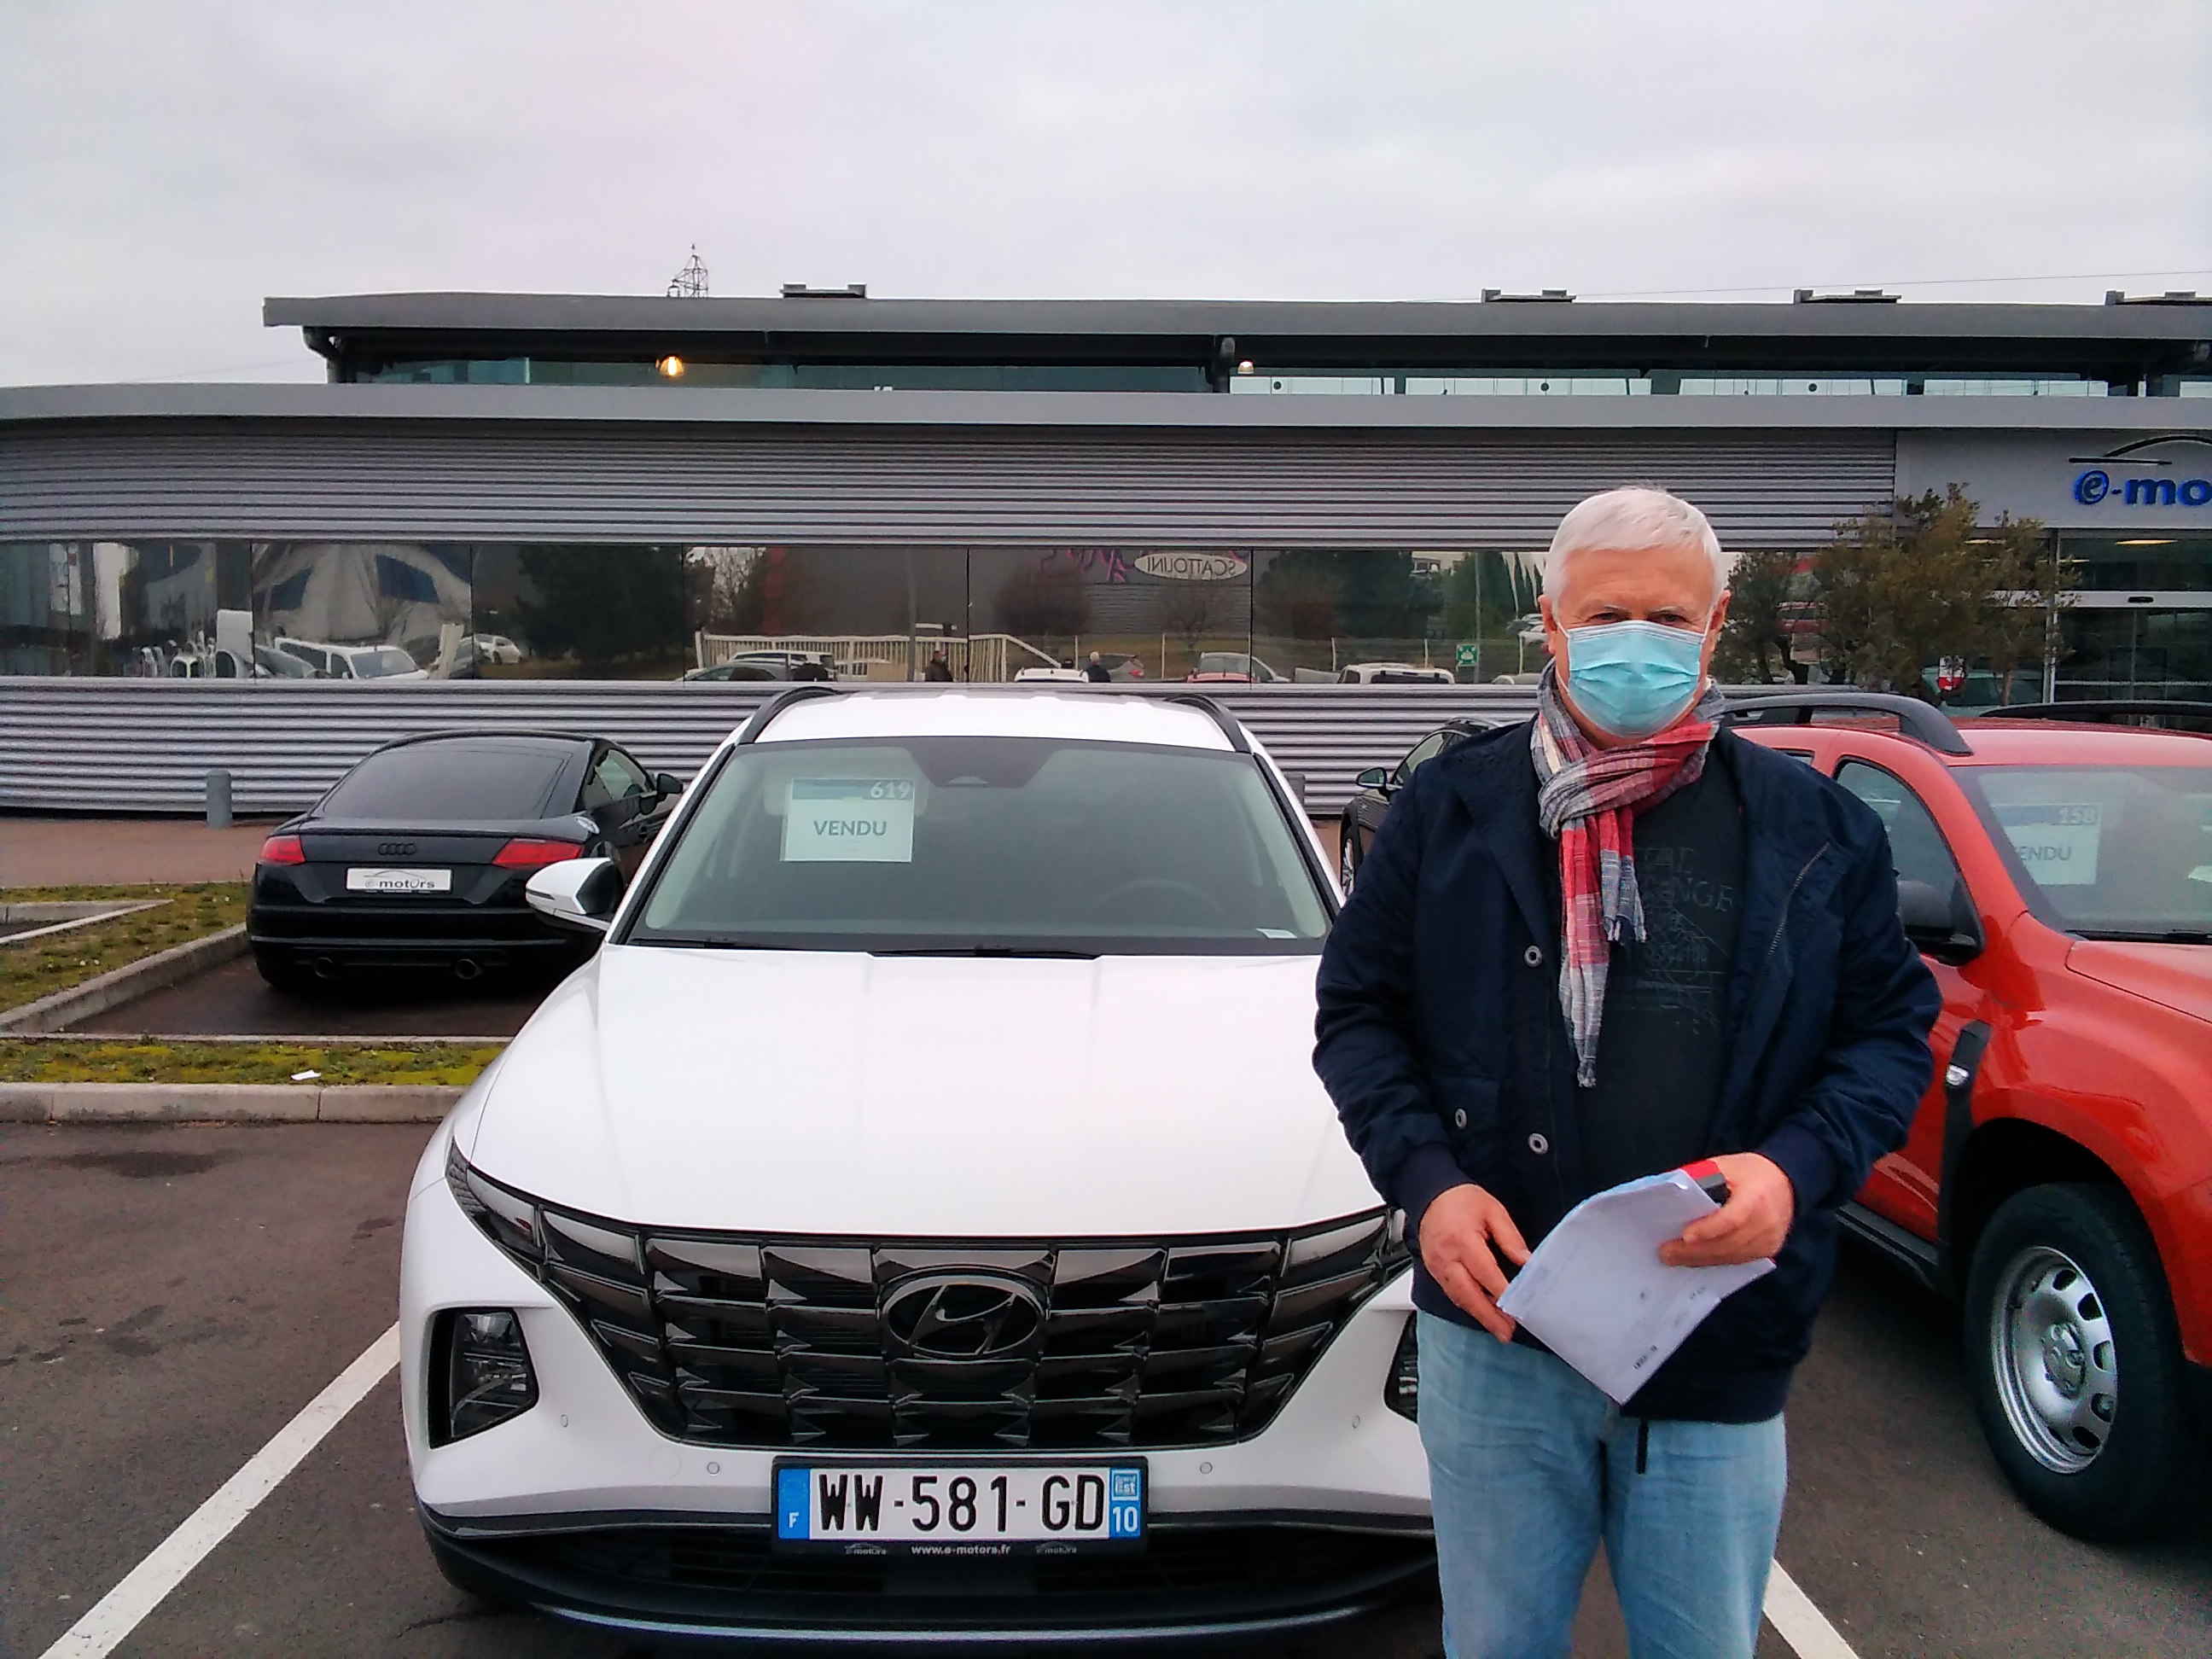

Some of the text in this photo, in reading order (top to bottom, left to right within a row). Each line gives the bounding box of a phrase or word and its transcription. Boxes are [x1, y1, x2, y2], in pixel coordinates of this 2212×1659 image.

[870, 781, 911, 799] 619
[813, 820, 887, 835] VENDU
[2016, 846, 2072, 861] ENDU
[788, 1473, 1138, 1533] F WW-581-GD 10
[911, 1544, 1011, 1555] www.e-motors.fr
